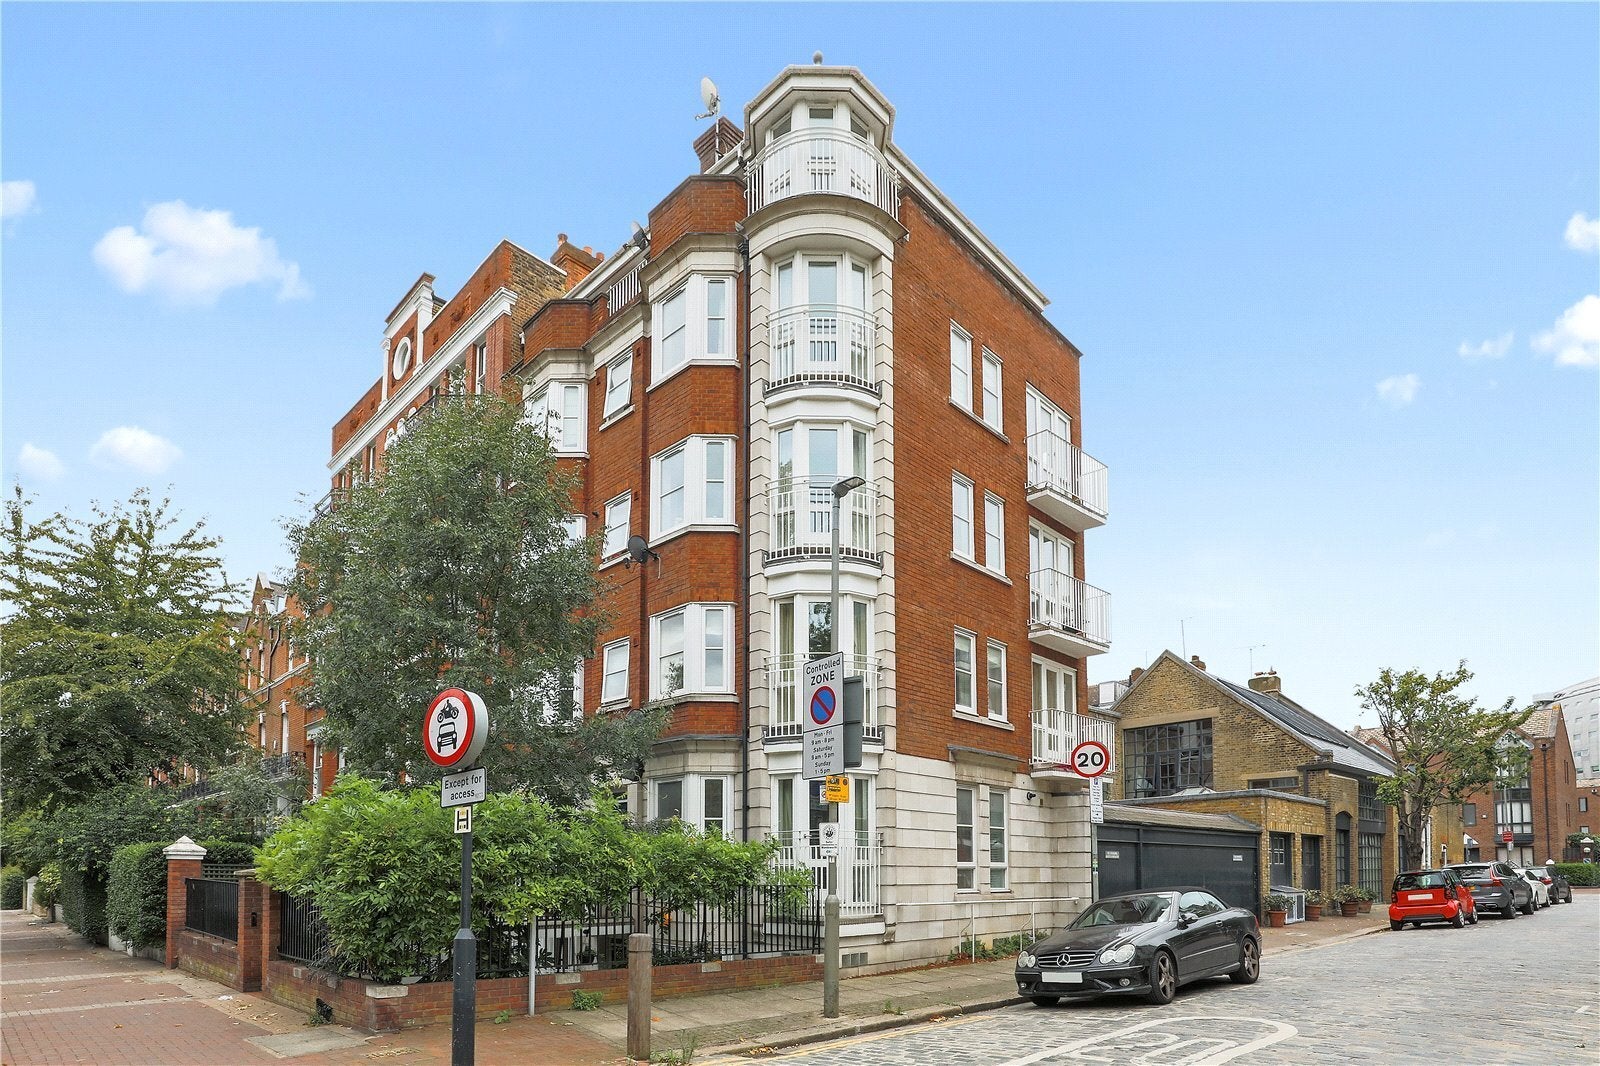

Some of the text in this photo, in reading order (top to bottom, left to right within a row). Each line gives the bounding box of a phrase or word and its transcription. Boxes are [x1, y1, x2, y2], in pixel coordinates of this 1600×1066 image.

[806, 657, 840, 675] Controlled
[811, 670, 835, 686] ZONE
[1077, 752, 1104, 767] 20
[445, 774, 482, 789] Except for
[450, 790, 475, 800] access
[457, 810, 468, 830] H
